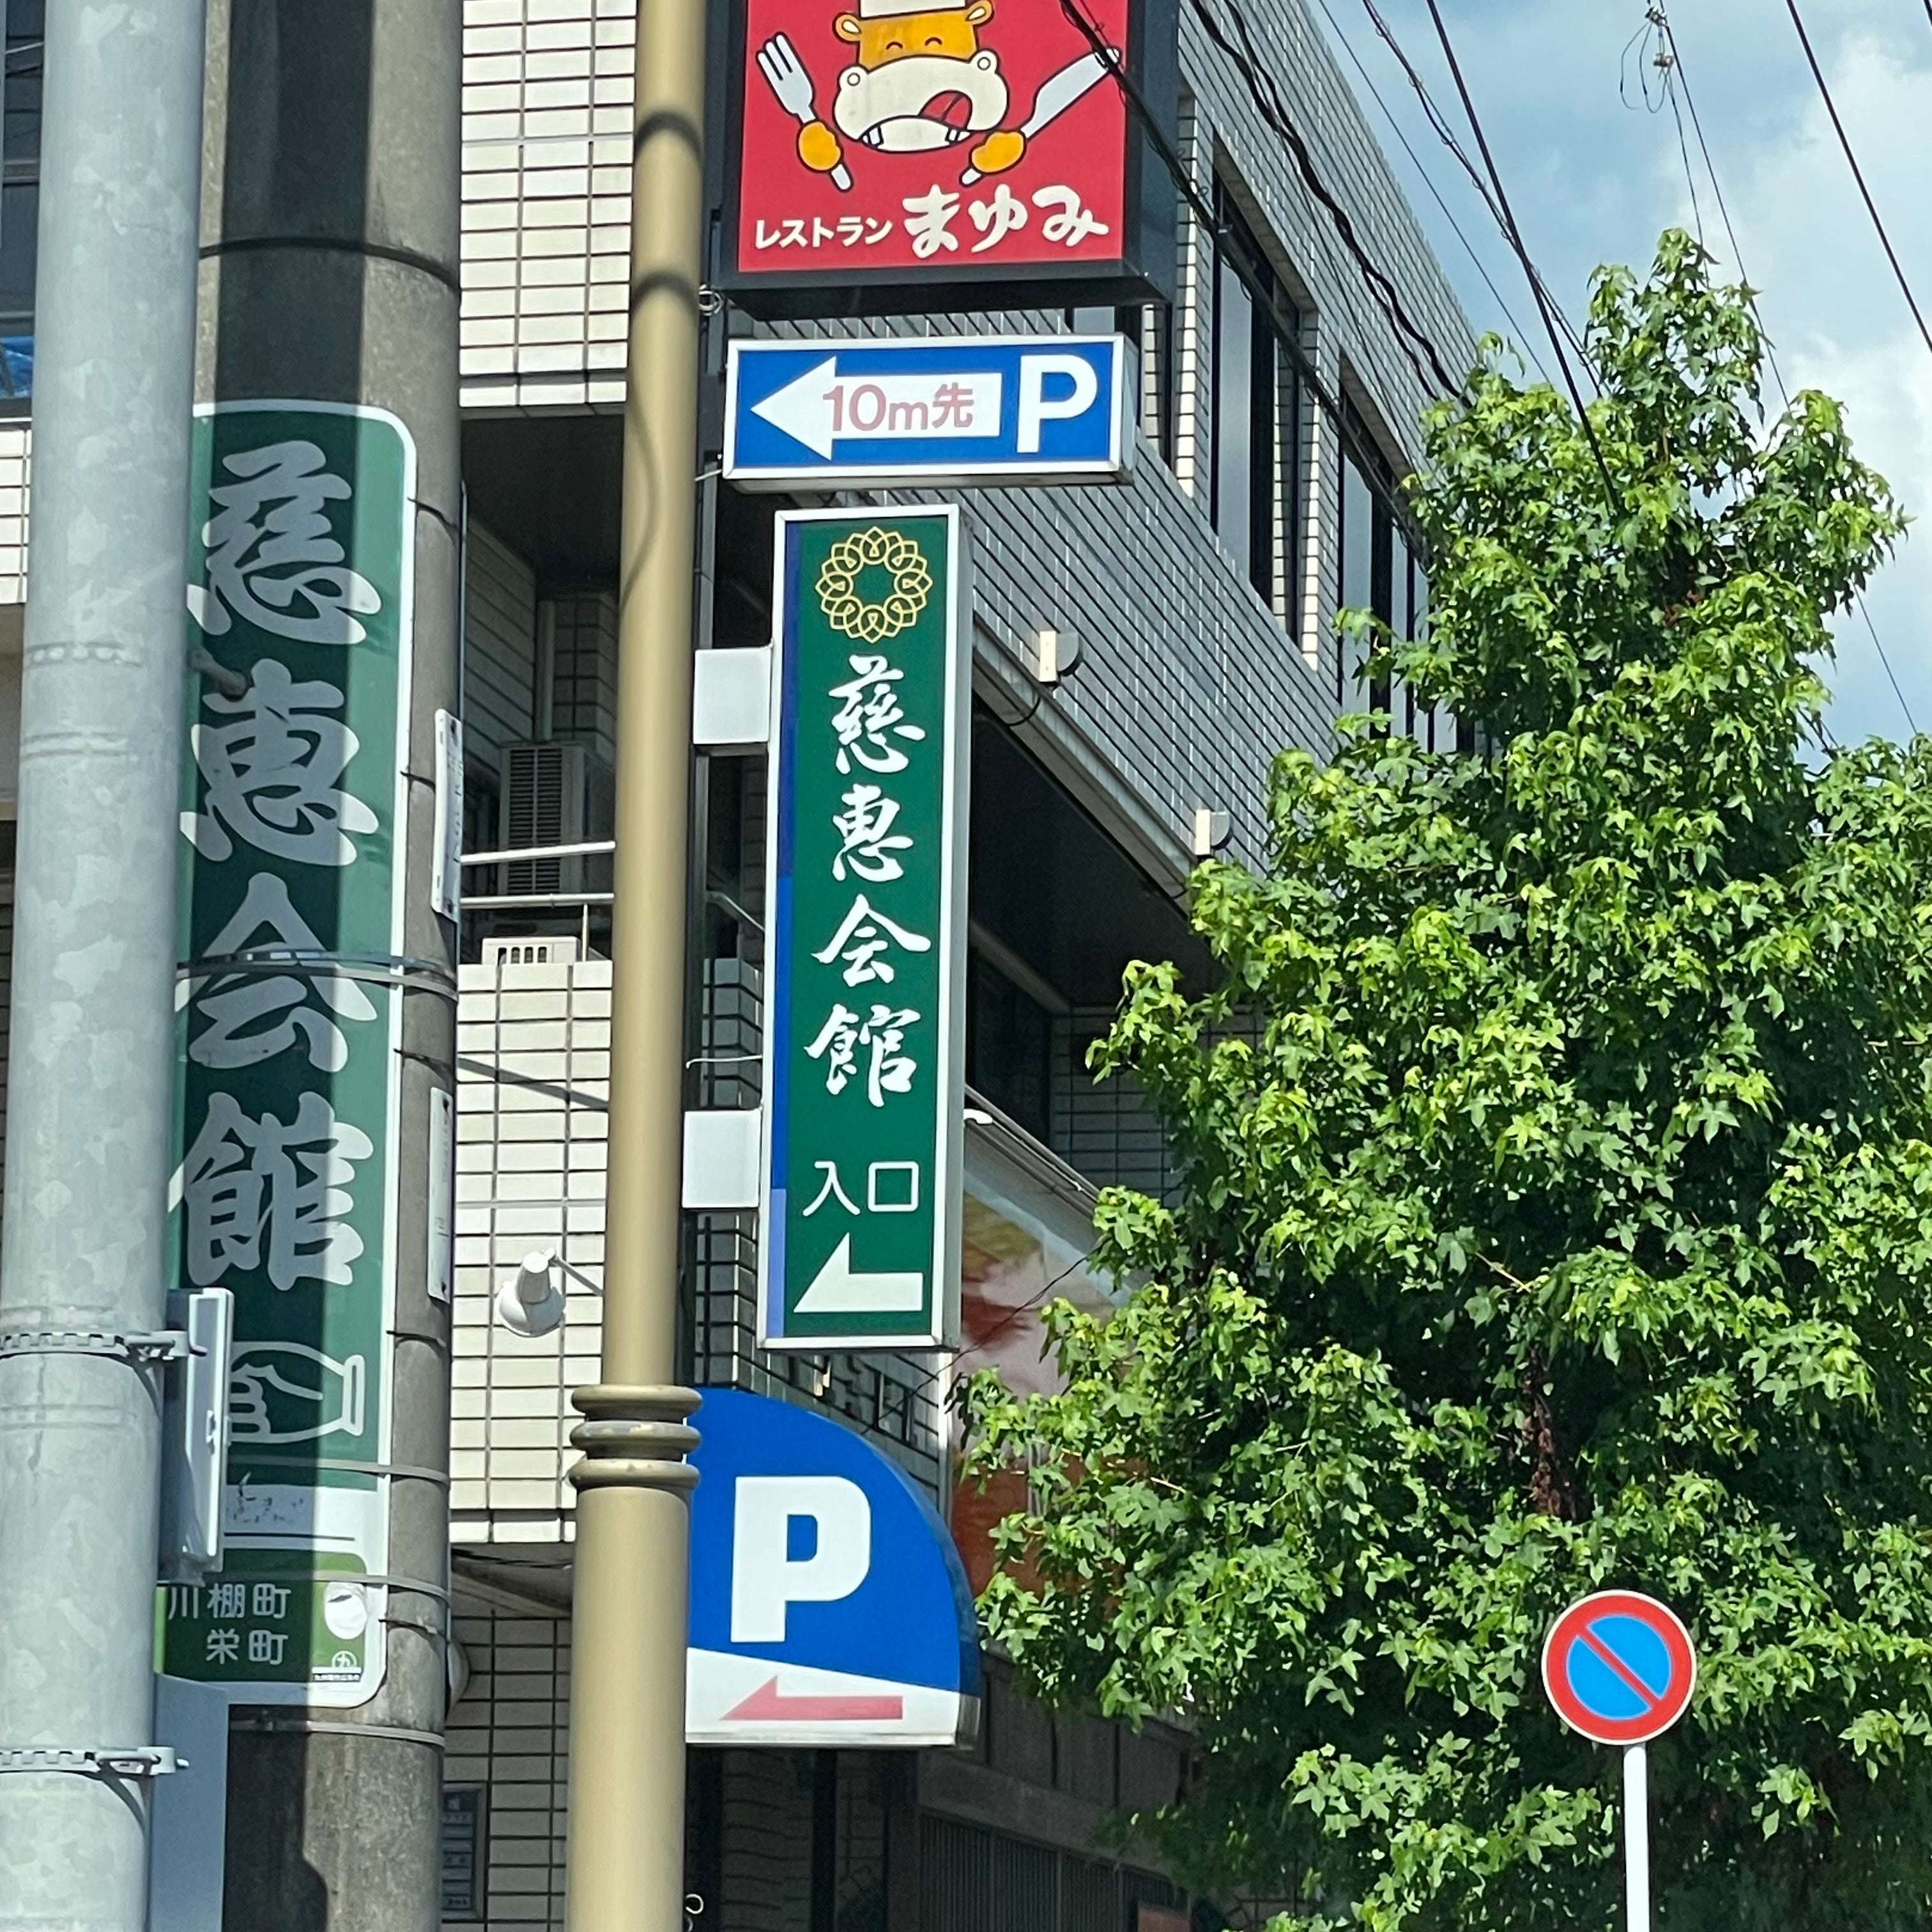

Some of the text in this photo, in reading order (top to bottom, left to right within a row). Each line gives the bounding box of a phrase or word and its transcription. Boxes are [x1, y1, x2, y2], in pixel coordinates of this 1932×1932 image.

[755, 183, 1109, 258] レストラン まゆみ
[823, 355, 1098, 453] 10m先 P
[168, 440, 381, 1291] 慈恵会館
[803, 654, 931, 1107] 慈恵会館
[802, 1161, 919, 1216] 入口
[168, 1583, 291, 1620] 川棚町
[731, 1476, 871, 1643] P
[206, 1629, 288, 1665] 栄町
